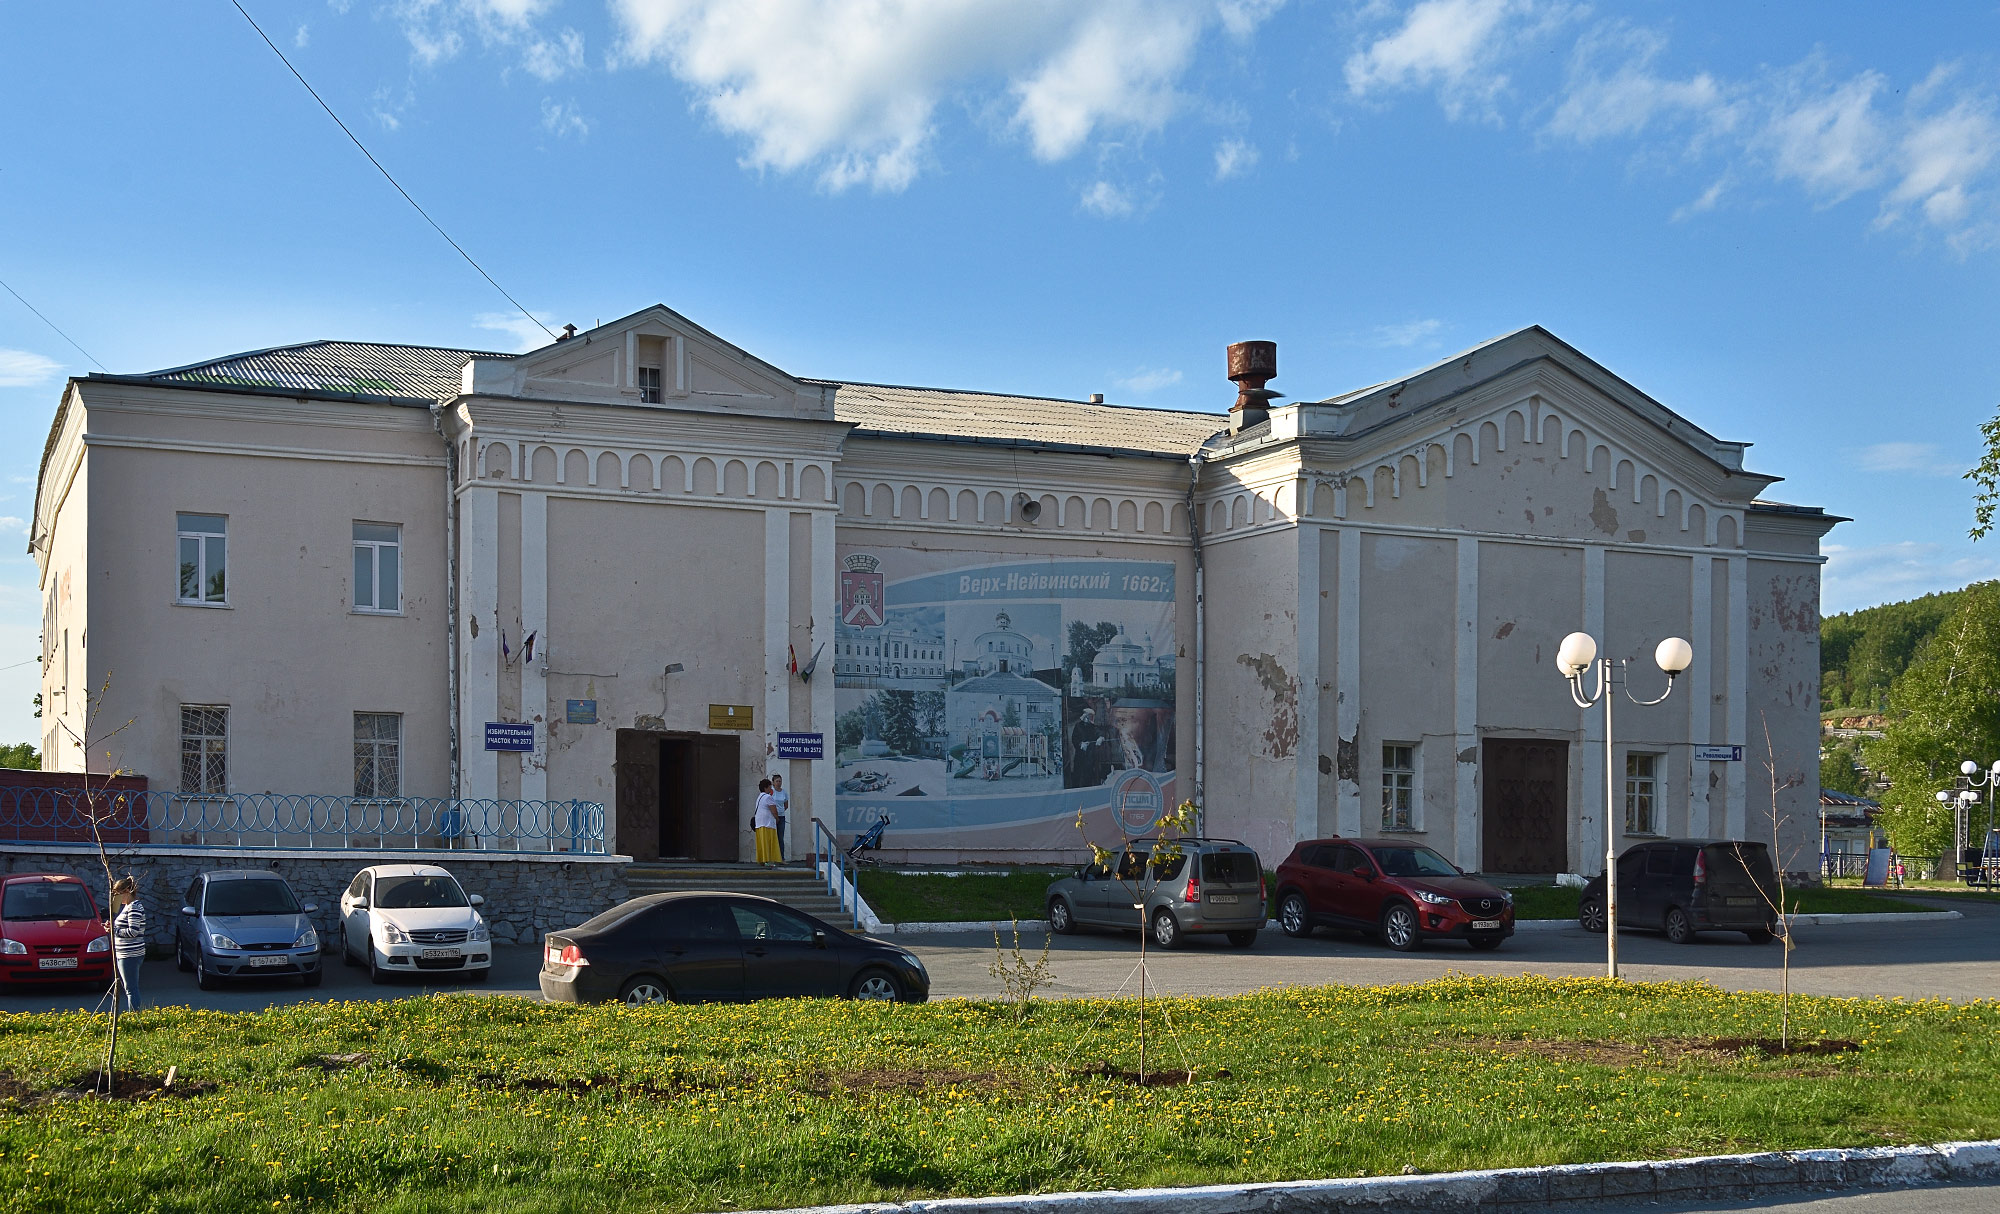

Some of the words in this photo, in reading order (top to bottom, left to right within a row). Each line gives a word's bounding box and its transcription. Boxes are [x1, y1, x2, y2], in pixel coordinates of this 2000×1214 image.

[959, 571, 1111, 596] Верх-Нейвинский
[1122, 574, 1170, 593] 1662г.
[487, 728, 532, 736] ИЗБИРАТЕЛЬНЫЙ
[780, 737, 822, 745] ИЗБИРАТЕЛЬНЫЙ
[1734, 748, 1740, 759] 1
